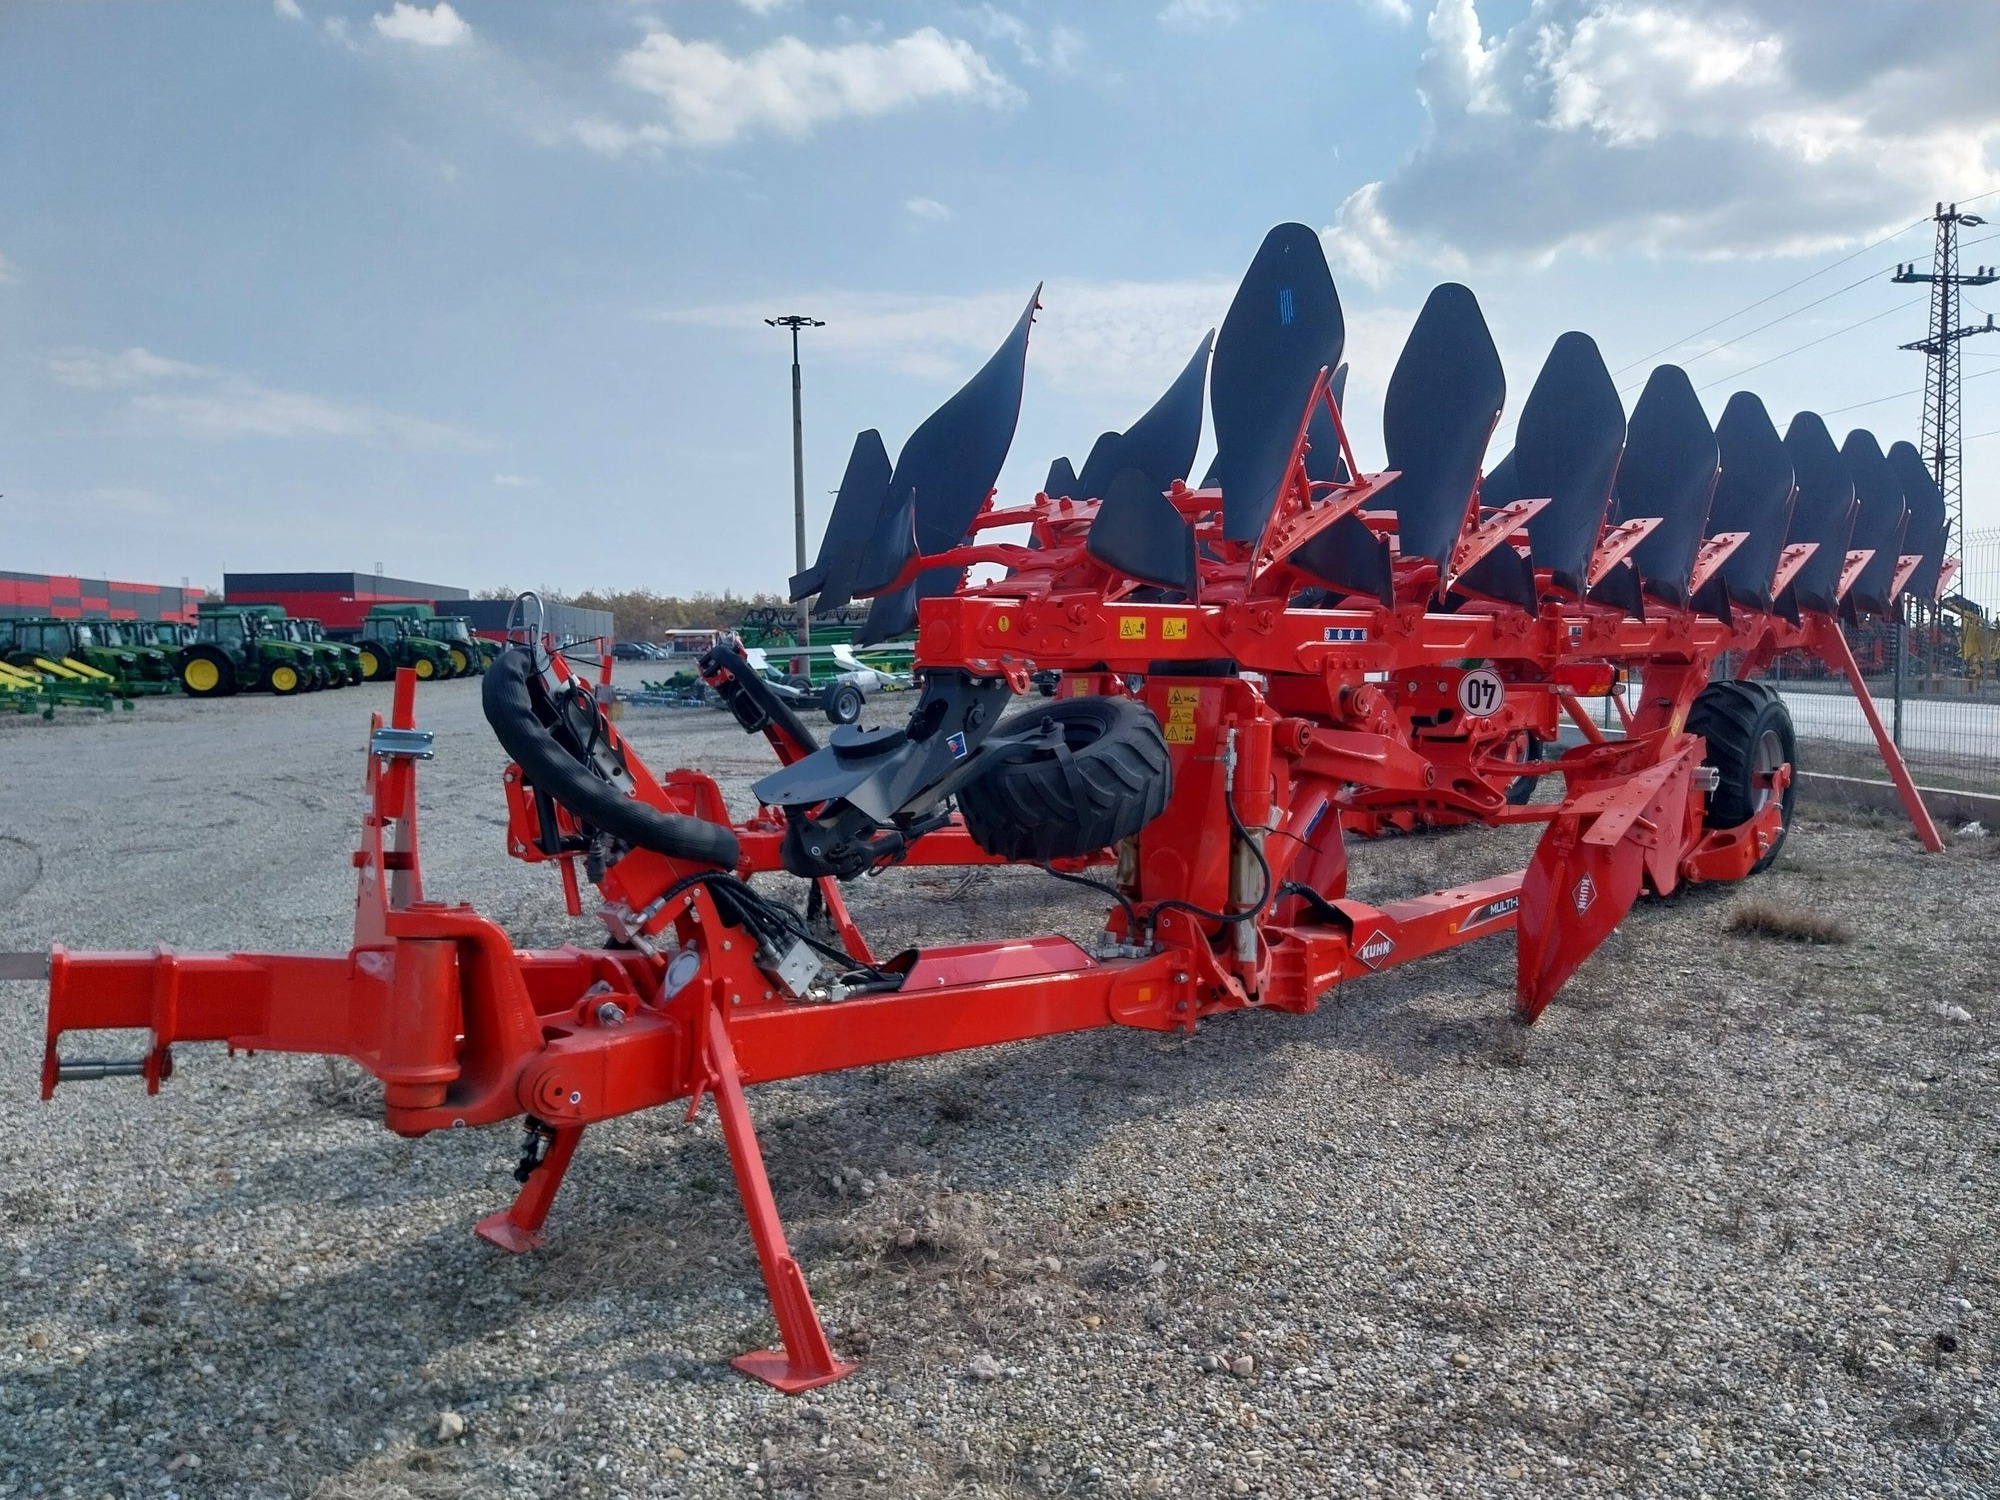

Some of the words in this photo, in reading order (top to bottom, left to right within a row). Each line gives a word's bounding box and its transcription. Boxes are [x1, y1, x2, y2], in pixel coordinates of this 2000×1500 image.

[1468, 679, 1496, 709] 40
[1578, 879, 1591, 909] KUHN
[1362, 941, 1390, 959] KUHN
